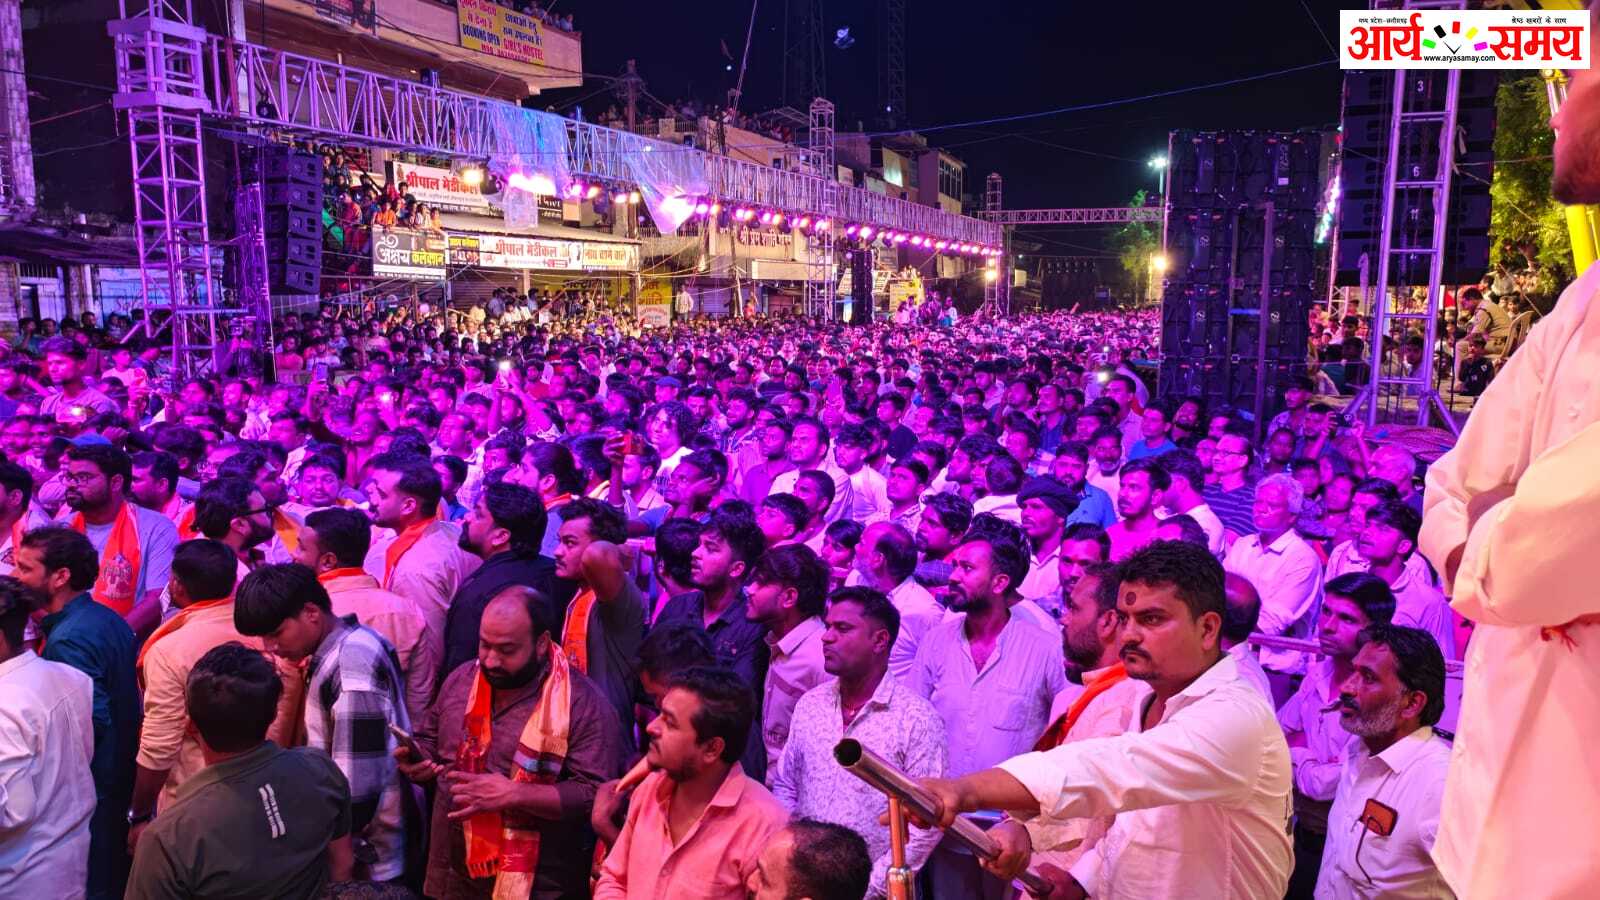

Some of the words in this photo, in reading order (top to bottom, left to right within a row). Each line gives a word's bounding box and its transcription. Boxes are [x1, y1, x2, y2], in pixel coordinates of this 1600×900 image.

[523, 45, 544, 60] HOSTEL
[1417, 80, 1424, 92] 3
[1413, 166, 1420, 177] 6
[406, 171, 440, 190] श्रीपाल
[375, 237, 410, 264] अक्षय
[495, 239, 524, 256] श्रीपाल
[527, 241, 557, 257] मेडीकल
